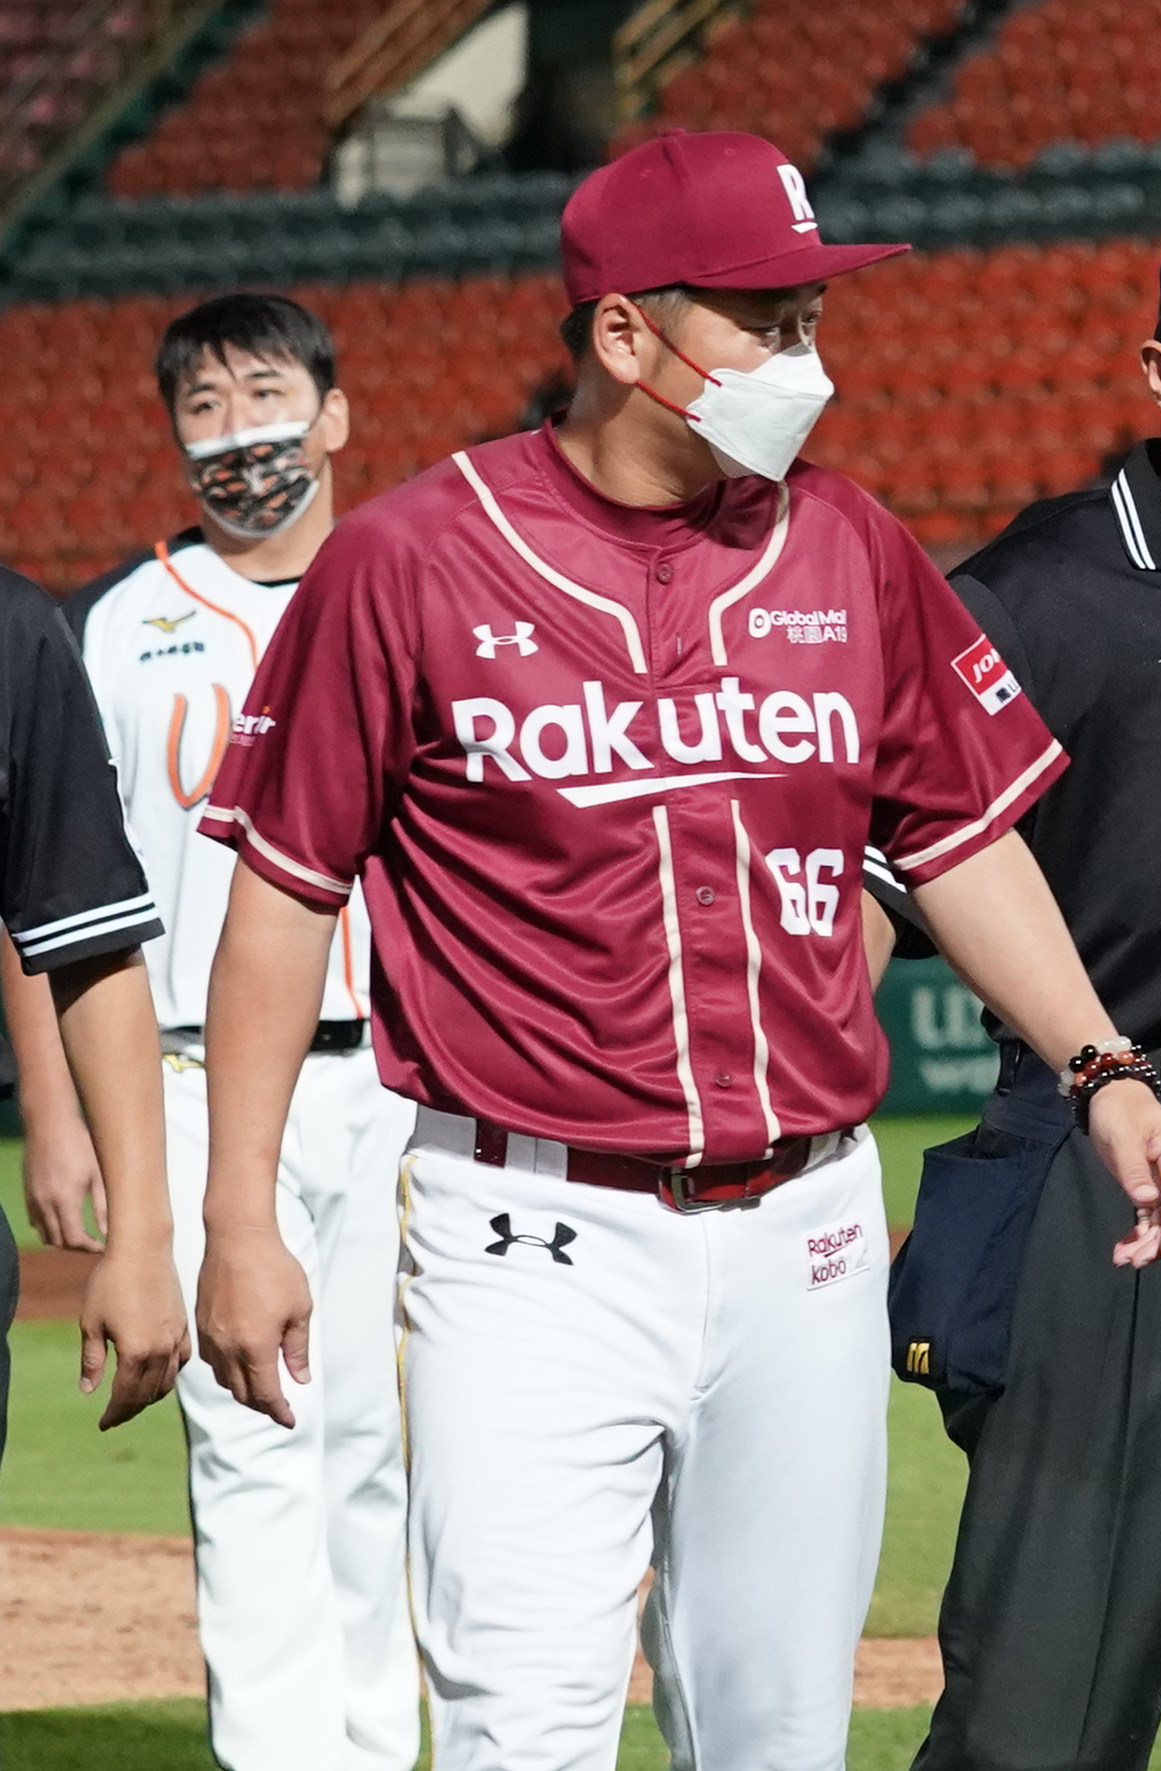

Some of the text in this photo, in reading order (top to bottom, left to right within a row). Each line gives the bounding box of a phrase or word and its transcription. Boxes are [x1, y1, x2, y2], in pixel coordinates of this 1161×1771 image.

[776, 164, 815, 221] R
[451, 677, 860, 784] Rakuten
[764, 848, 845, 937] 66
[807, 1224, 864, 1258] Rakuten
